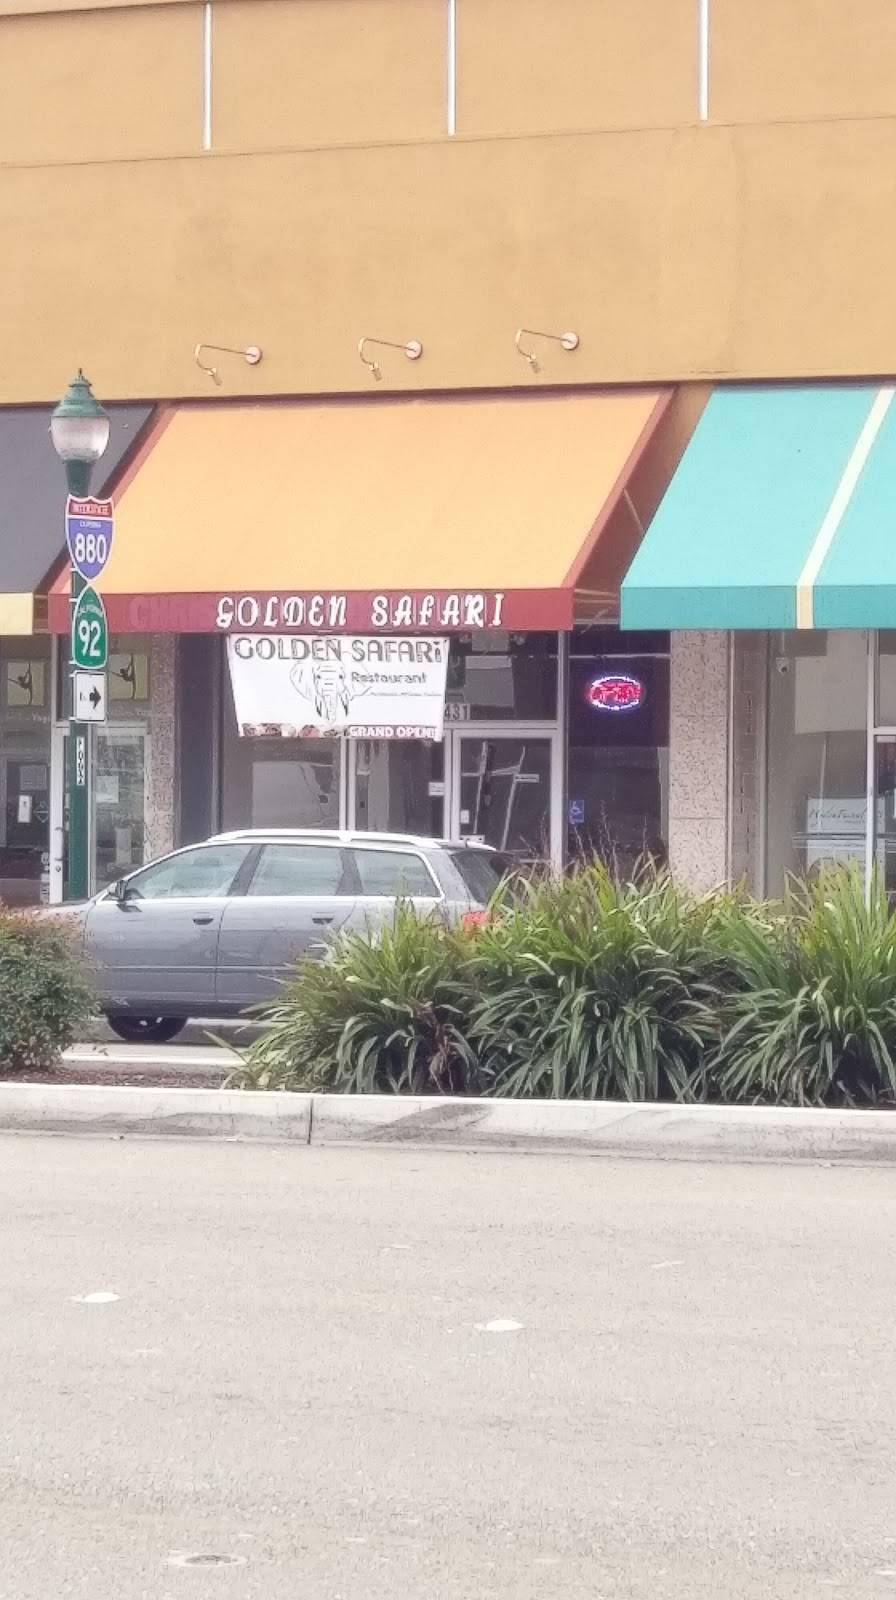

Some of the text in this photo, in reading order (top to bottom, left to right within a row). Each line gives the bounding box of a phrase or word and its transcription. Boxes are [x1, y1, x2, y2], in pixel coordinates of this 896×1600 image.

[76, 533, 106, 564] 880
[215, 595, 347, 628] GOLDEN
[371, 593, 504, 628] SAFARI
[78, 621, 101, 656] 92
[234, 636, 342, 661] GOLDEN
[351, 671, 427, 684] Restaurant
[349, 725, 394, 738] GRAND
